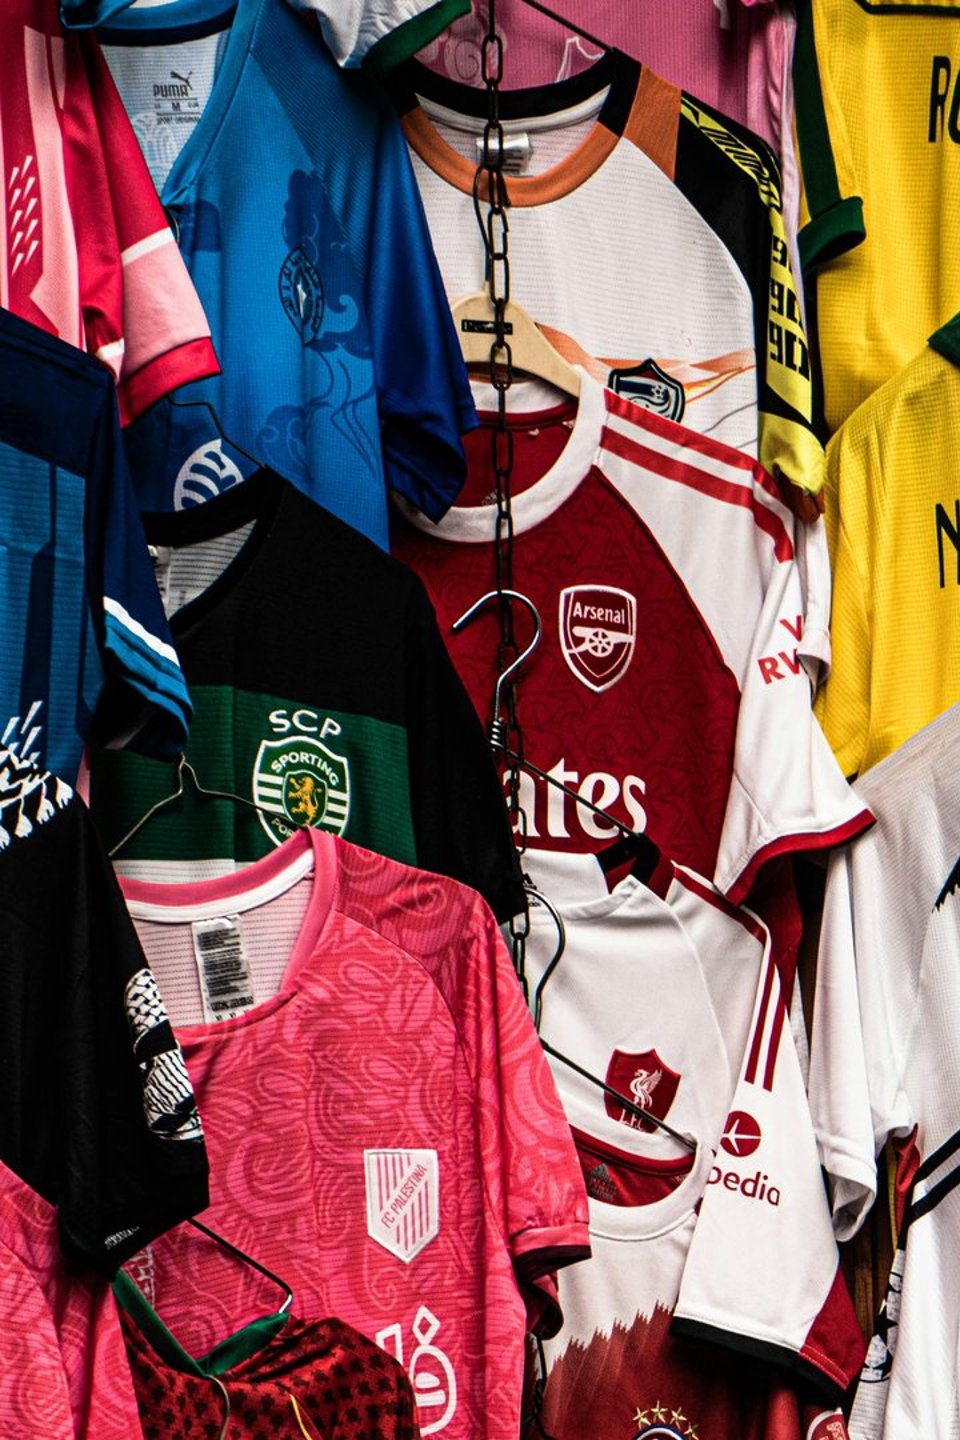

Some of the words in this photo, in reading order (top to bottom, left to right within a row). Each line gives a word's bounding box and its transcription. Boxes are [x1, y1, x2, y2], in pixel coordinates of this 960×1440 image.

[572, 601, 625, 624] Arsenal
[268, 709, 342, 738] SCP
[270, 751, 340, 787] SPORTING
[380, 1211, 396, 1230] FC
[390, 1163, 428, 1216] PALESTINA
